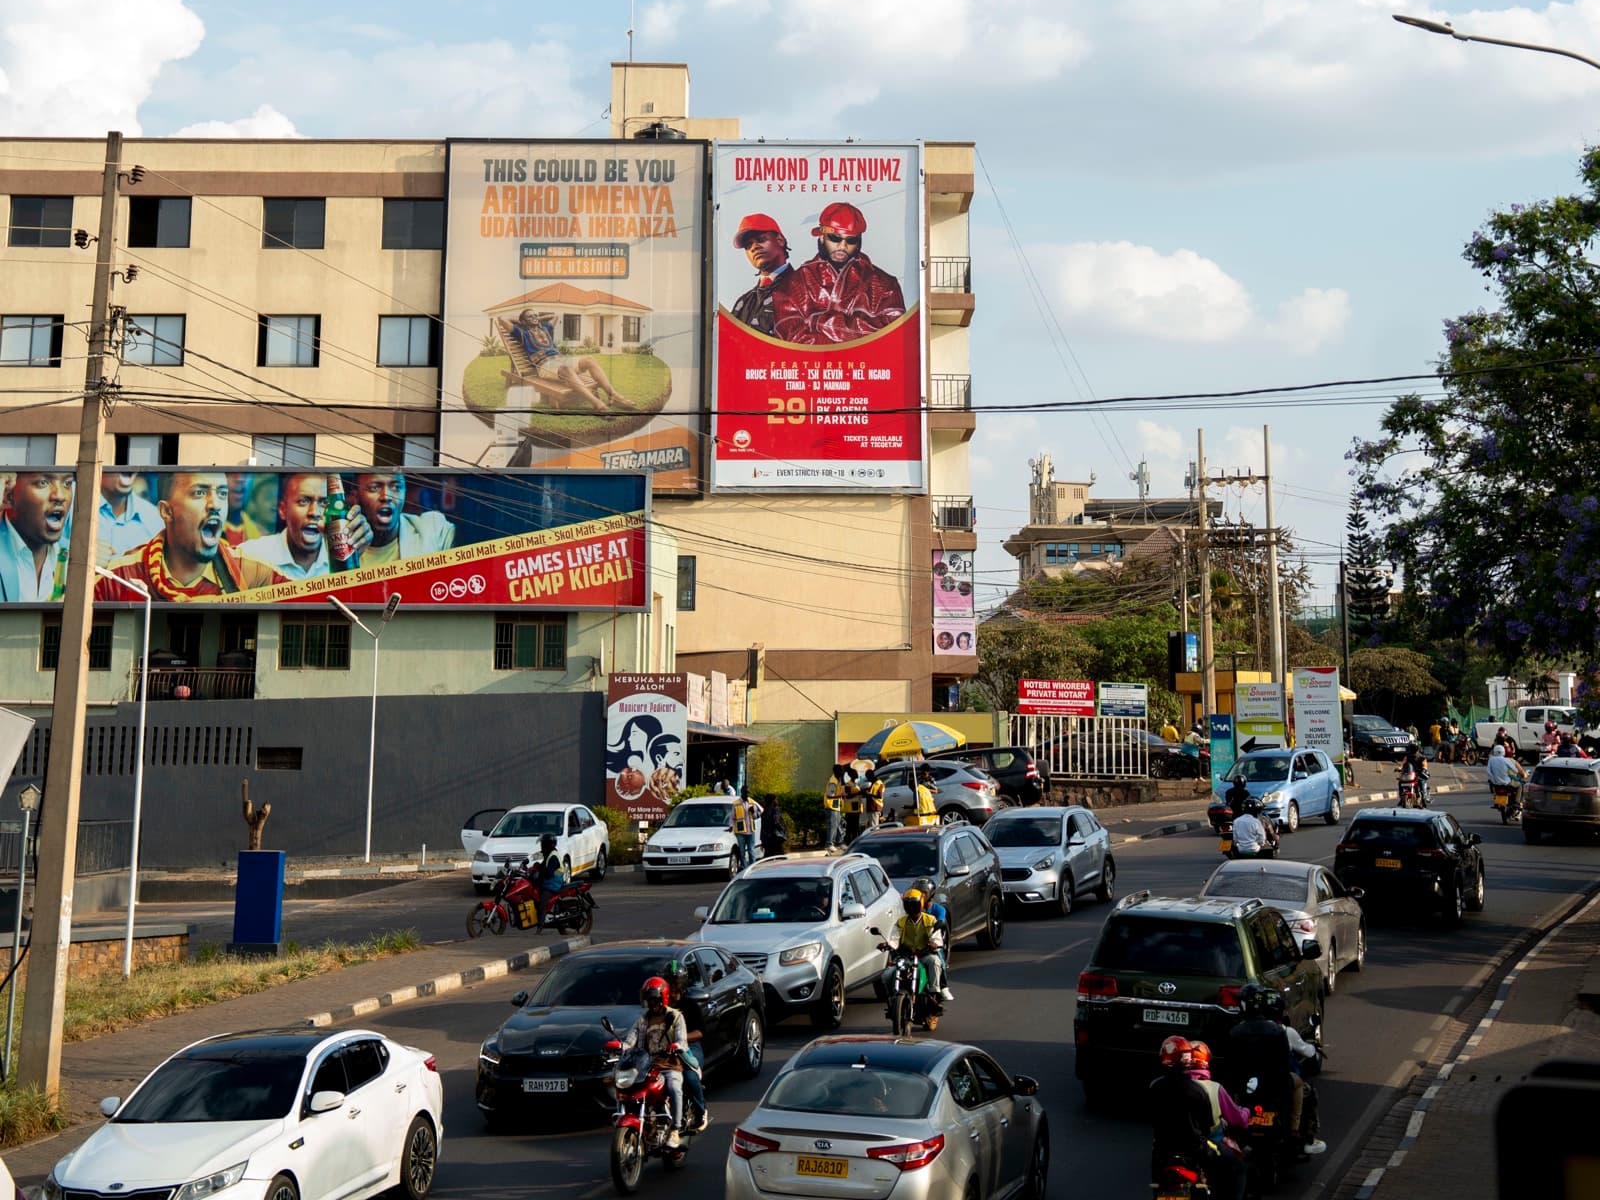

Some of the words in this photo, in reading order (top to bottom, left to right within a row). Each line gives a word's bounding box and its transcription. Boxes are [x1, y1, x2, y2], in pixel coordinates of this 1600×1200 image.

[483, 159, 527, 182] THIS
[534, 159, 597, 182] COULD
[604, 160, 628, 182] BE
[635, 160, 676, 182] YOU
[735, 158, 808, 181] DIAMOND
[820, 158, 901, 182] PLATNUMZ
[766, 184, 873, 192] EXPERIENCE
[481, 185, 560, 214] ARIKO
[568, 185, 674, 214] UMENYA
[480, 216, 582, 238] UDAKUNDA
[588, 216, 678, 238] IKIBANZA
[745, 369, 767, 380] BRUCE
[770, 369, 799, 380] MELODIE
[808, 369, 819, 380] ISH
[823, 369, 843, 380] KEVIN
[852, 369, 864, 380] NEL
[868, 369, 890, 380] NGABO
[767, 398, 806, 424] 29
[816, 415, 869, 424] PARKING
[601, 448, 684, 470] TENGAMARA
[256, 588, 274, 602] Skol
[278, 585, 297, 598] Malt
[306, 578, 325, 592] Skol
[328, 575, 347, 588] Malt
[356, 570, 375, 582] Skol
[377, 565, 397, 578] Malt
[406, 558, 424, 572] Skol
[427, 554, 447, 568] Malt
[455, 548, 474, 561] Skol
[477, 544, 497, 558] Malt
[505, 538, 524, 552] Skol
[526, 534, 546, 548] Malt
[554, 528, 574, 541] Skol
[576, 524, 596, 537] Malt
[604, 518, 623, 532] Skol
[626, 514, 645, 527] Malt
[505, 551, 564, 580] GAMES
[566, 542, 604, 568] LIVE
[608, 538, 628, 560] AT
[508, 572, 565, 602] CAMP
[568, 558, 633, 591] KIGALI
[434, 588, 445, 596] 18+
[619, 703, 647, 712] Manicure
[650, 703, 676, 712] Pedicure
